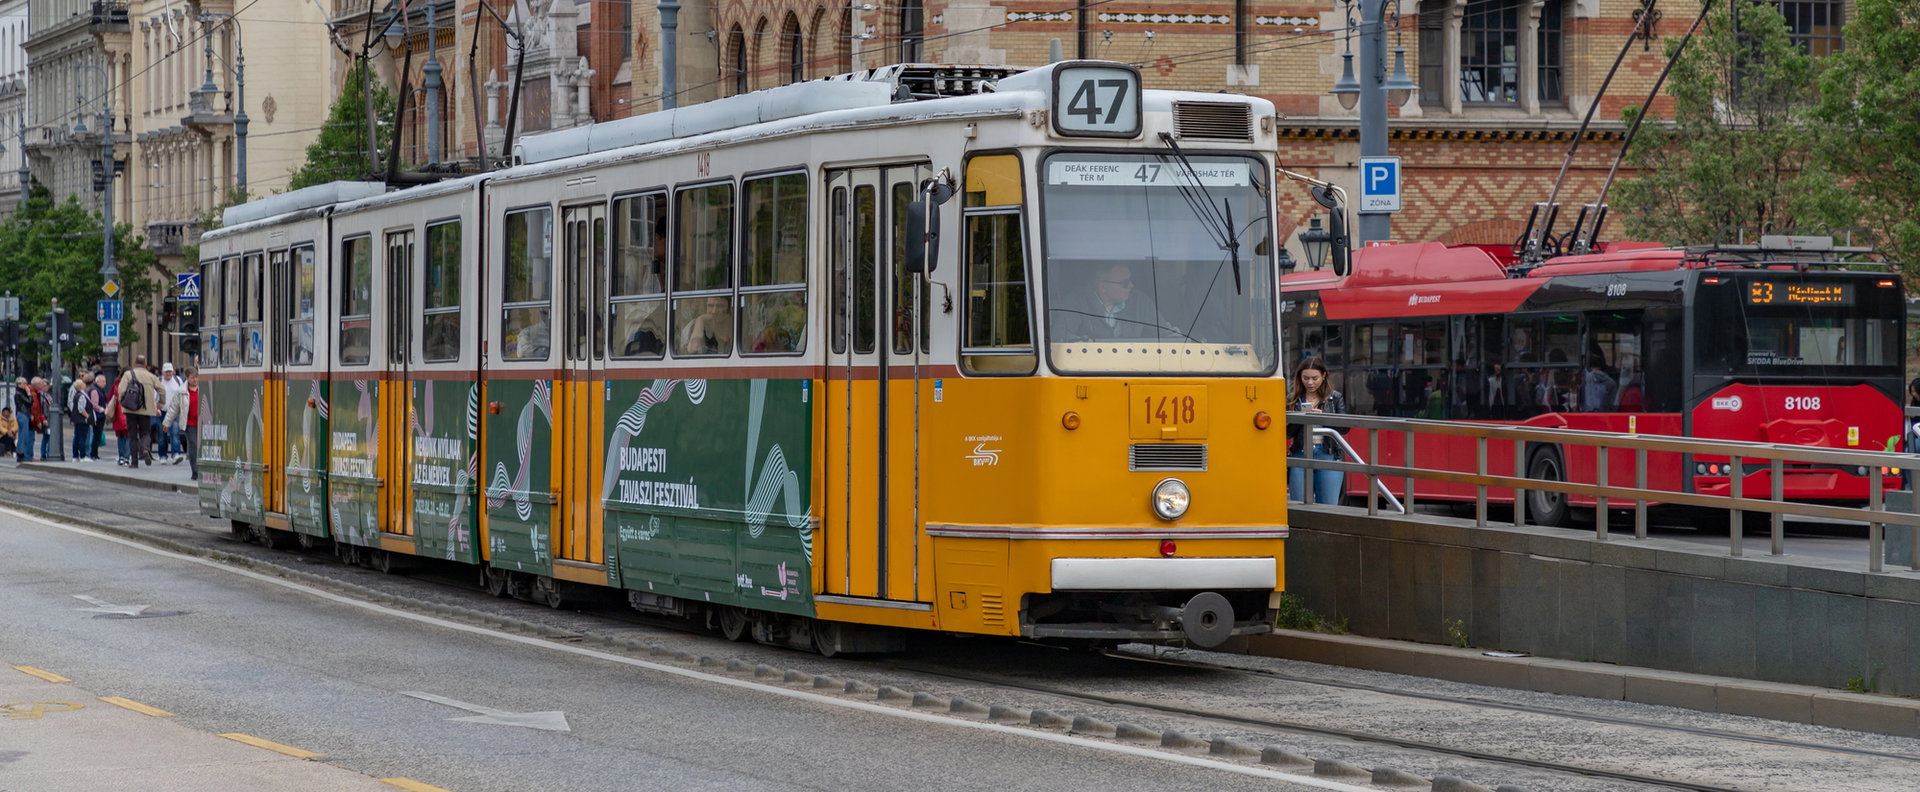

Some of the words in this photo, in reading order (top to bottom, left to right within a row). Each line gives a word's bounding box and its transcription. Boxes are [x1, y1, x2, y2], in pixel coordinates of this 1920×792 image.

[1067, 79, 1128, 124] 47
[697, 152, 710, 178] 1418
[1065, 164, 1087, 173] DEÁK
[1089, 165, 1120, 173] FERENC
[1134, 164, 1161, 183] 47
[1220, 169, 1235, 178] TÉR
[1079, 173, 1094, 182] TÉR
[1096, 174, 1105, 182] M
[1371, 166, 1389, 191] P
[1369, 199, 1392, 207] ZÓNA
[1417, 295, 1442, 304] BUDAPEST
[1607, 284, 1627, 297] 8108
[105, 324, 115, 337] P
[1145, 395, 1195, 425] 1418
[1784, 396, 1821, 410] 8108
[333, 431, 357, 451] BUDAPESTI
[438, 432, 462, 460] NYÍLNAK
[620, 447, 667, 473] BUDAPESTI
[414, 464, 423, 484] AZ
[423, 457, 450, 486] ÉLMÉNYEK
[619, 479, 652, 505] TAVASZI
[653, 475, 699, 509] FESZTIVÁL
